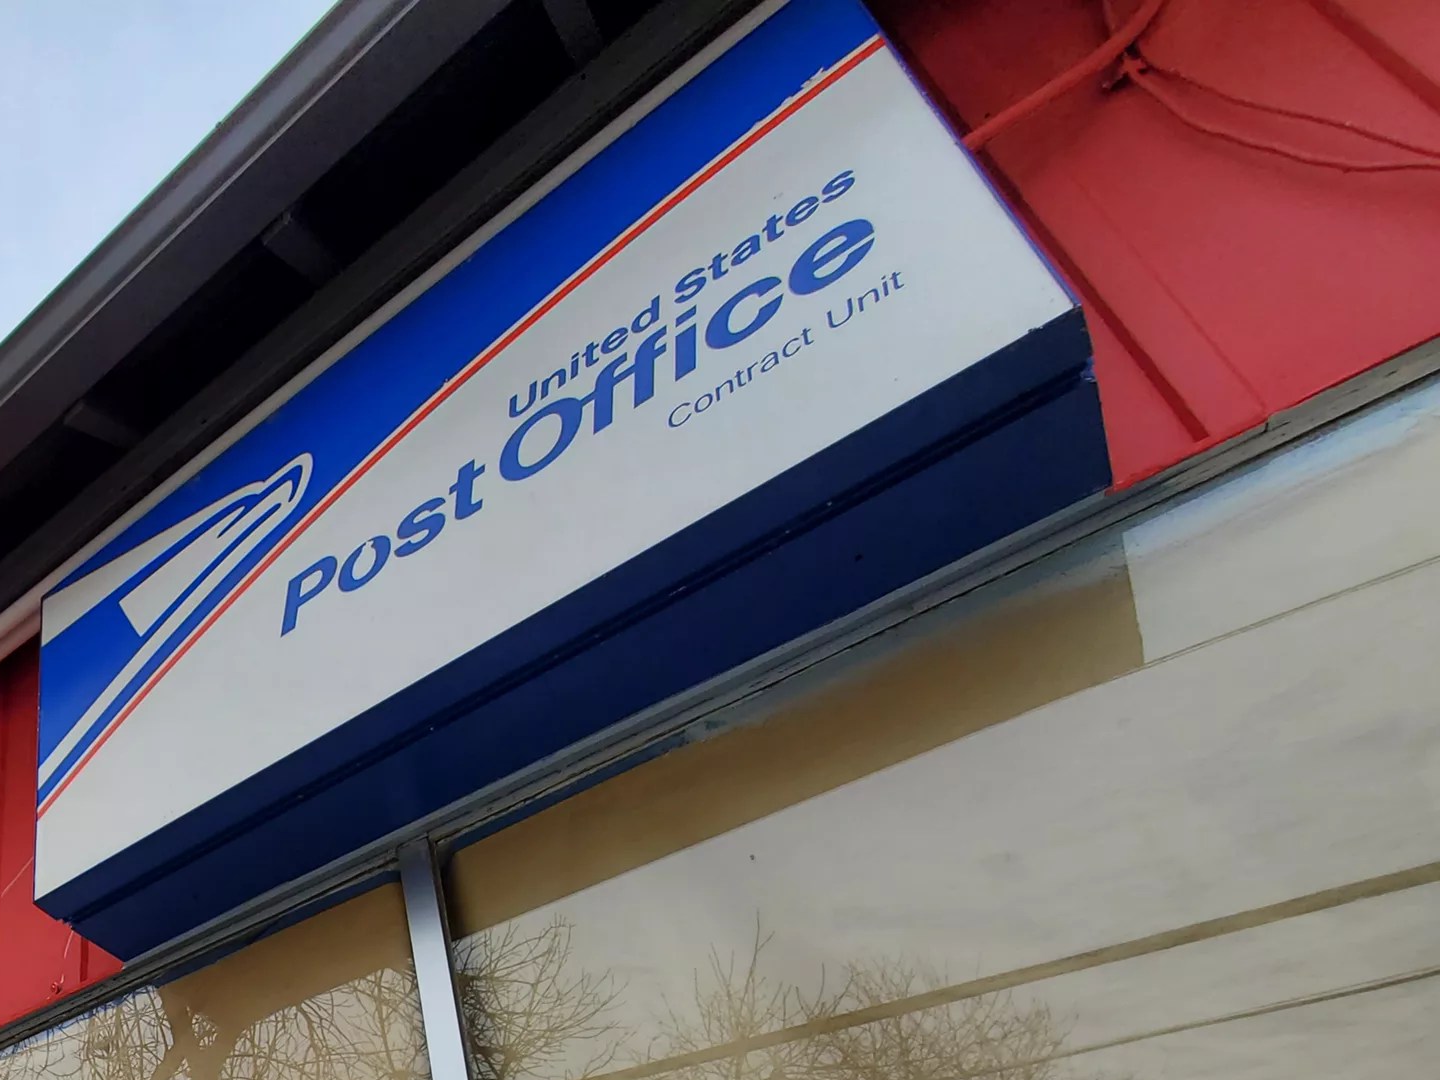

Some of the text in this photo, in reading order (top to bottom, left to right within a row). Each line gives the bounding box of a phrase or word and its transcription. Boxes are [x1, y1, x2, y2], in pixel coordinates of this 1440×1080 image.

[509, 170, 855, 418] United States
[667, 270, 905, 428] Contract Unit
[280, 218, 875, 637] Post Office
